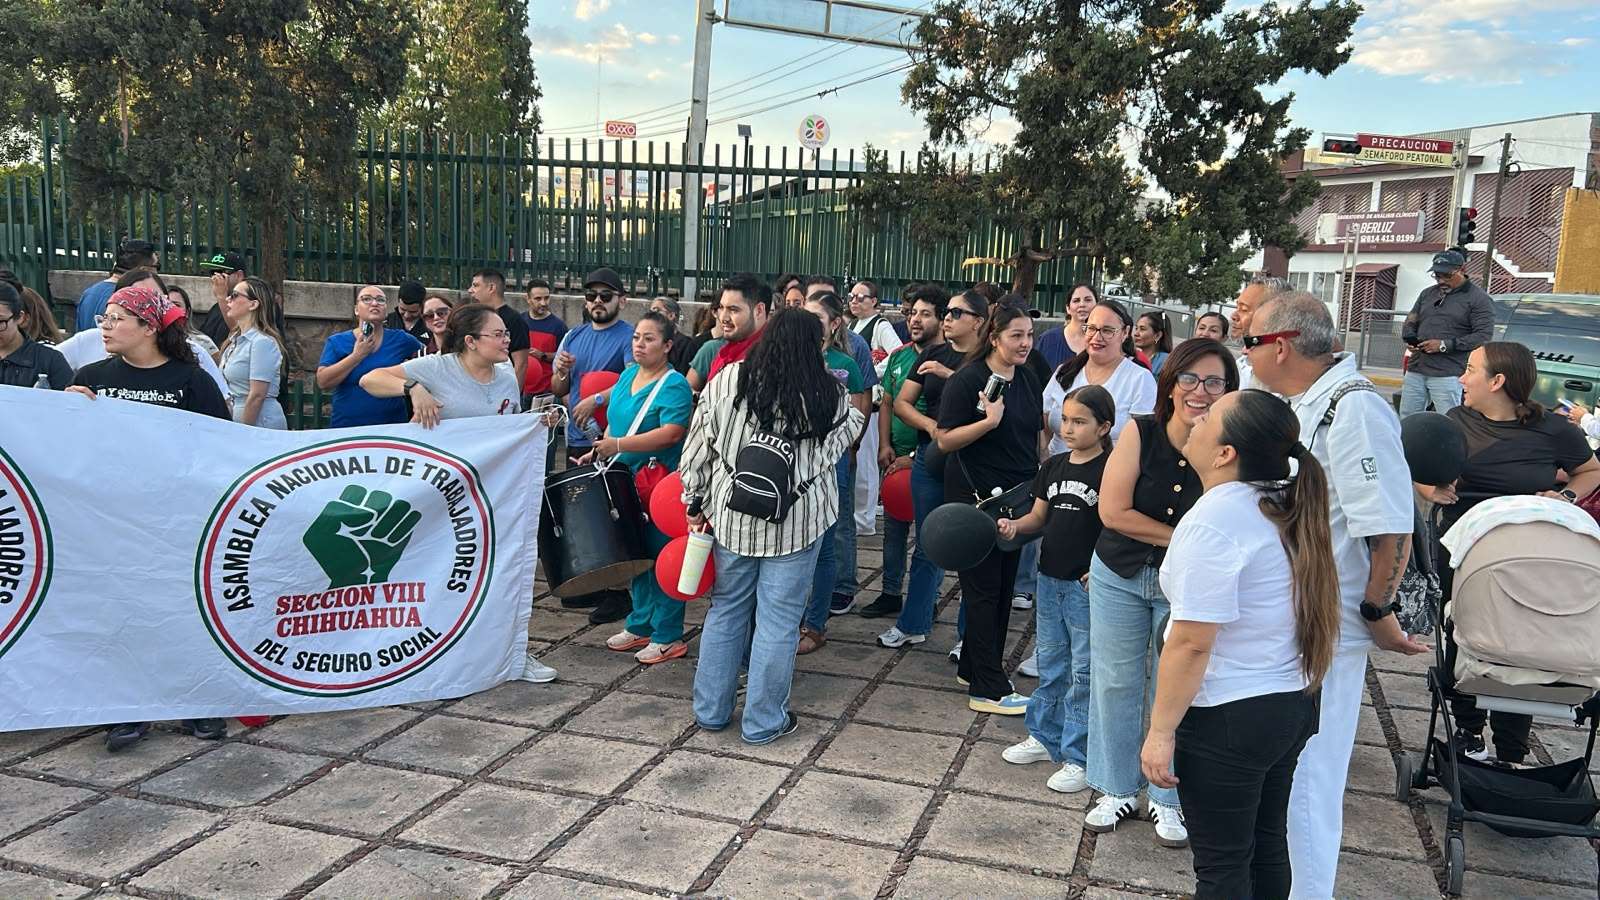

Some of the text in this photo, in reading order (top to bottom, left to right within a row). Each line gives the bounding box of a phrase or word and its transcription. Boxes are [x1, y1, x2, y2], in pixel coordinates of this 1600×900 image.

[608, 123, 636, 136] OXXO
[1371, 137, 1439, 151] PRECAUCION
[1364, 149, 1444, 164] SEMAFORO PEATONAL
[222, 455, 477, 612] ASAMBLEA NACIONAL DE TRABAJADORES
[275, 582, 426, 616] SECCION VIII
[276, 606, 423, 638] CHIHUAHUA
[253, 626, 443, 673] DEL SEGURO SOCIAL
